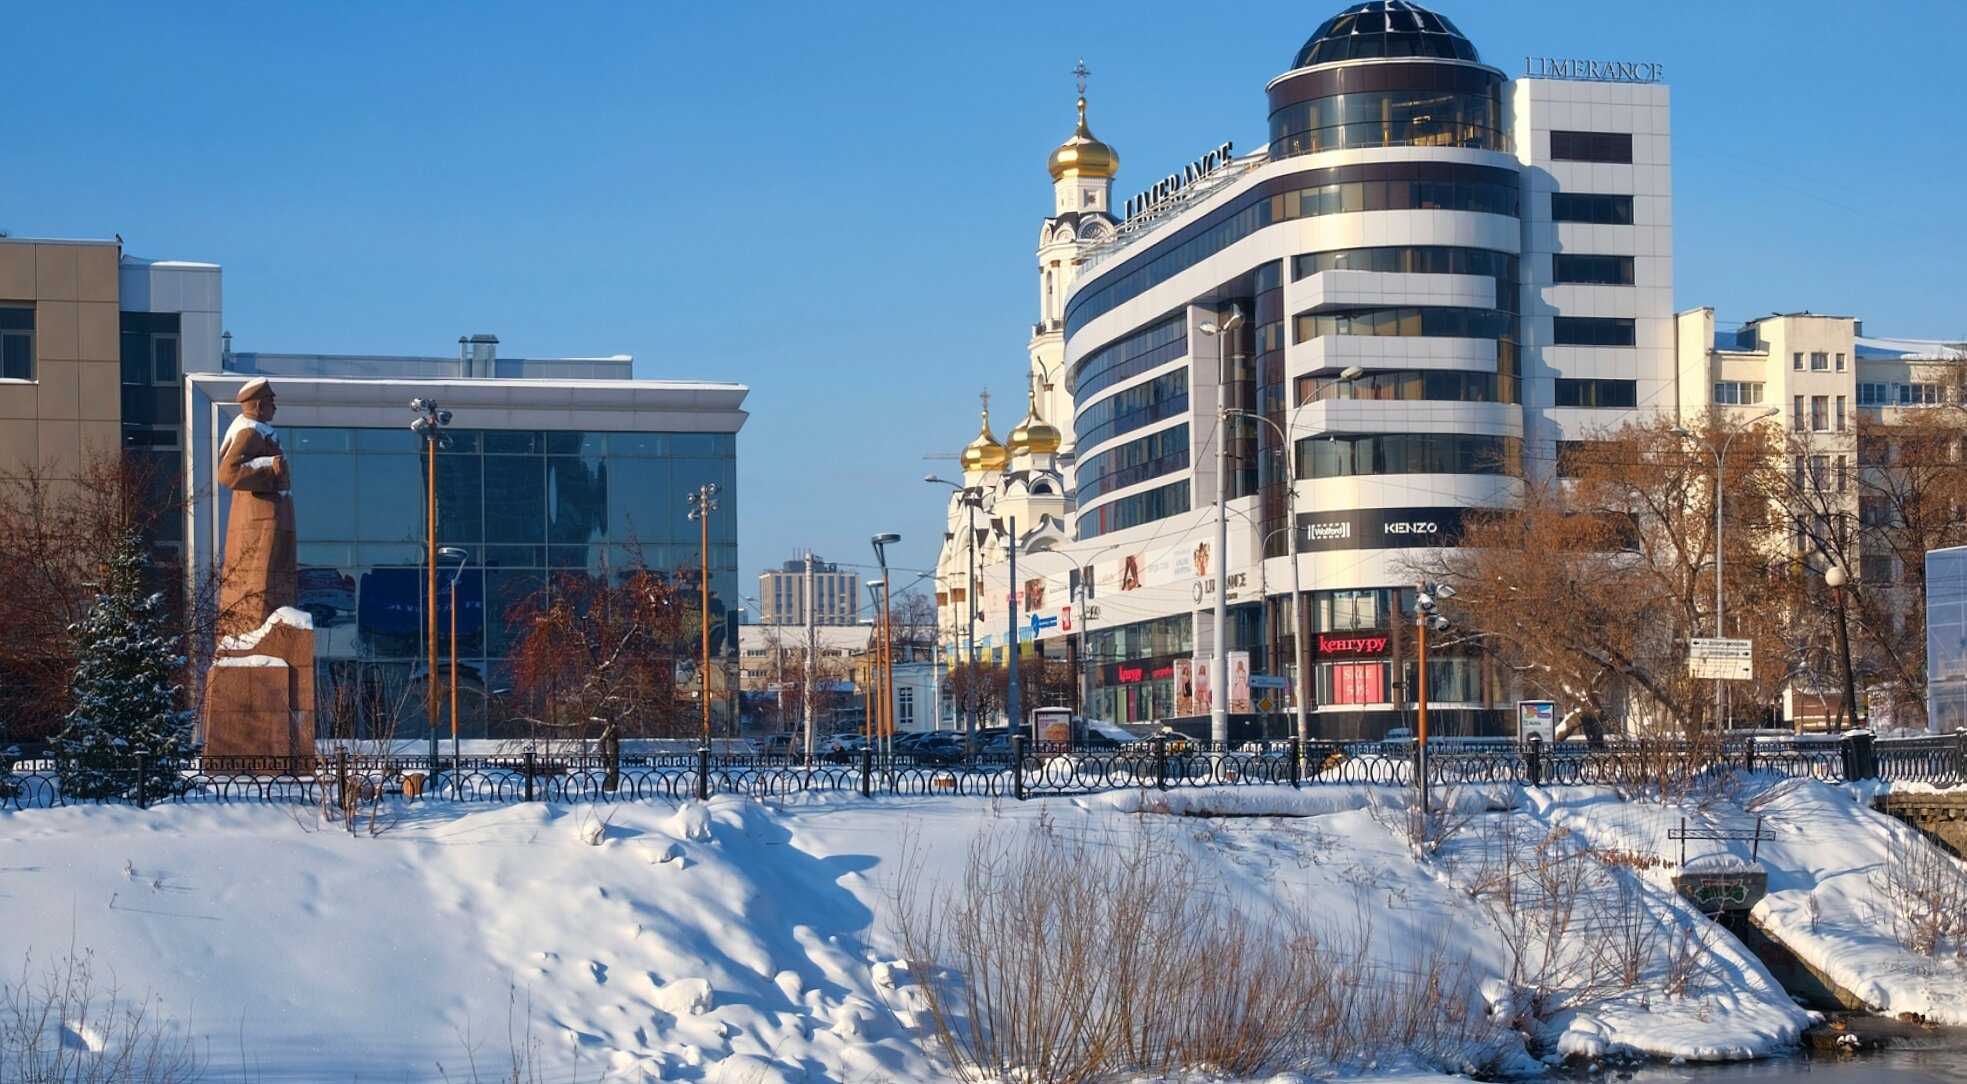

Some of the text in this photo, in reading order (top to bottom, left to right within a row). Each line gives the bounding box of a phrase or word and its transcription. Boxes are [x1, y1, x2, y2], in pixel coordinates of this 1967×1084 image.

[1526, 56, 1664, 81] LIMERANCE
[1124, 141, 1233, 232] LIMERANCE
[1384, 522, 1438, 534] KENZO
[1319, 635, 1388, 653] кенгуру
